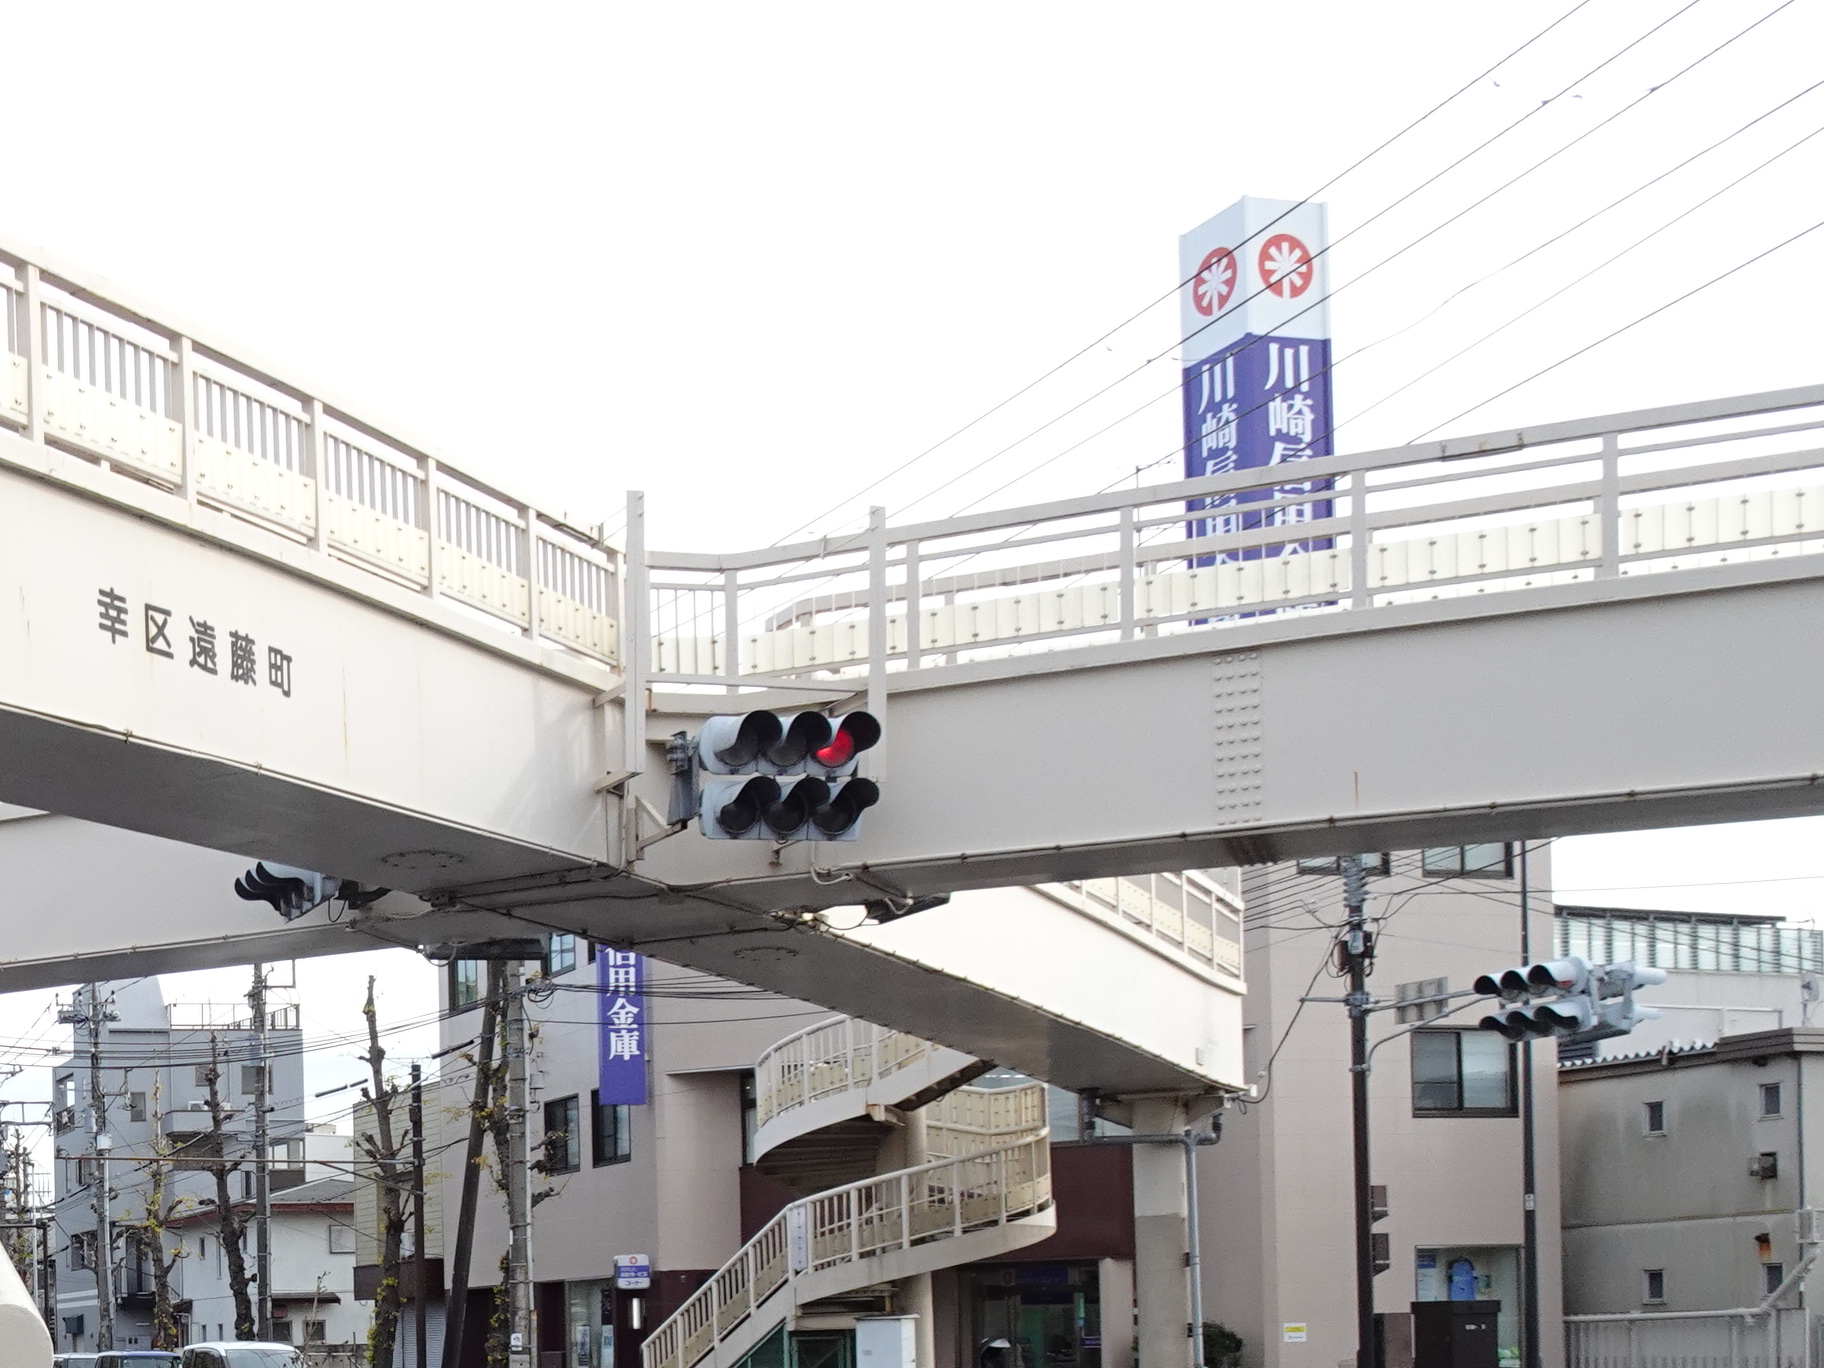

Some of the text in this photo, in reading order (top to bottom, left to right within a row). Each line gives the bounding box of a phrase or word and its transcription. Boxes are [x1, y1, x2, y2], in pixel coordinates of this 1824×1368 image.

[1265, 343, 1316, 614] 川崎信用
[97, 587, 292, 698] 幸区遠藤町
[605, 947, 641, 1060] 信用金庫
